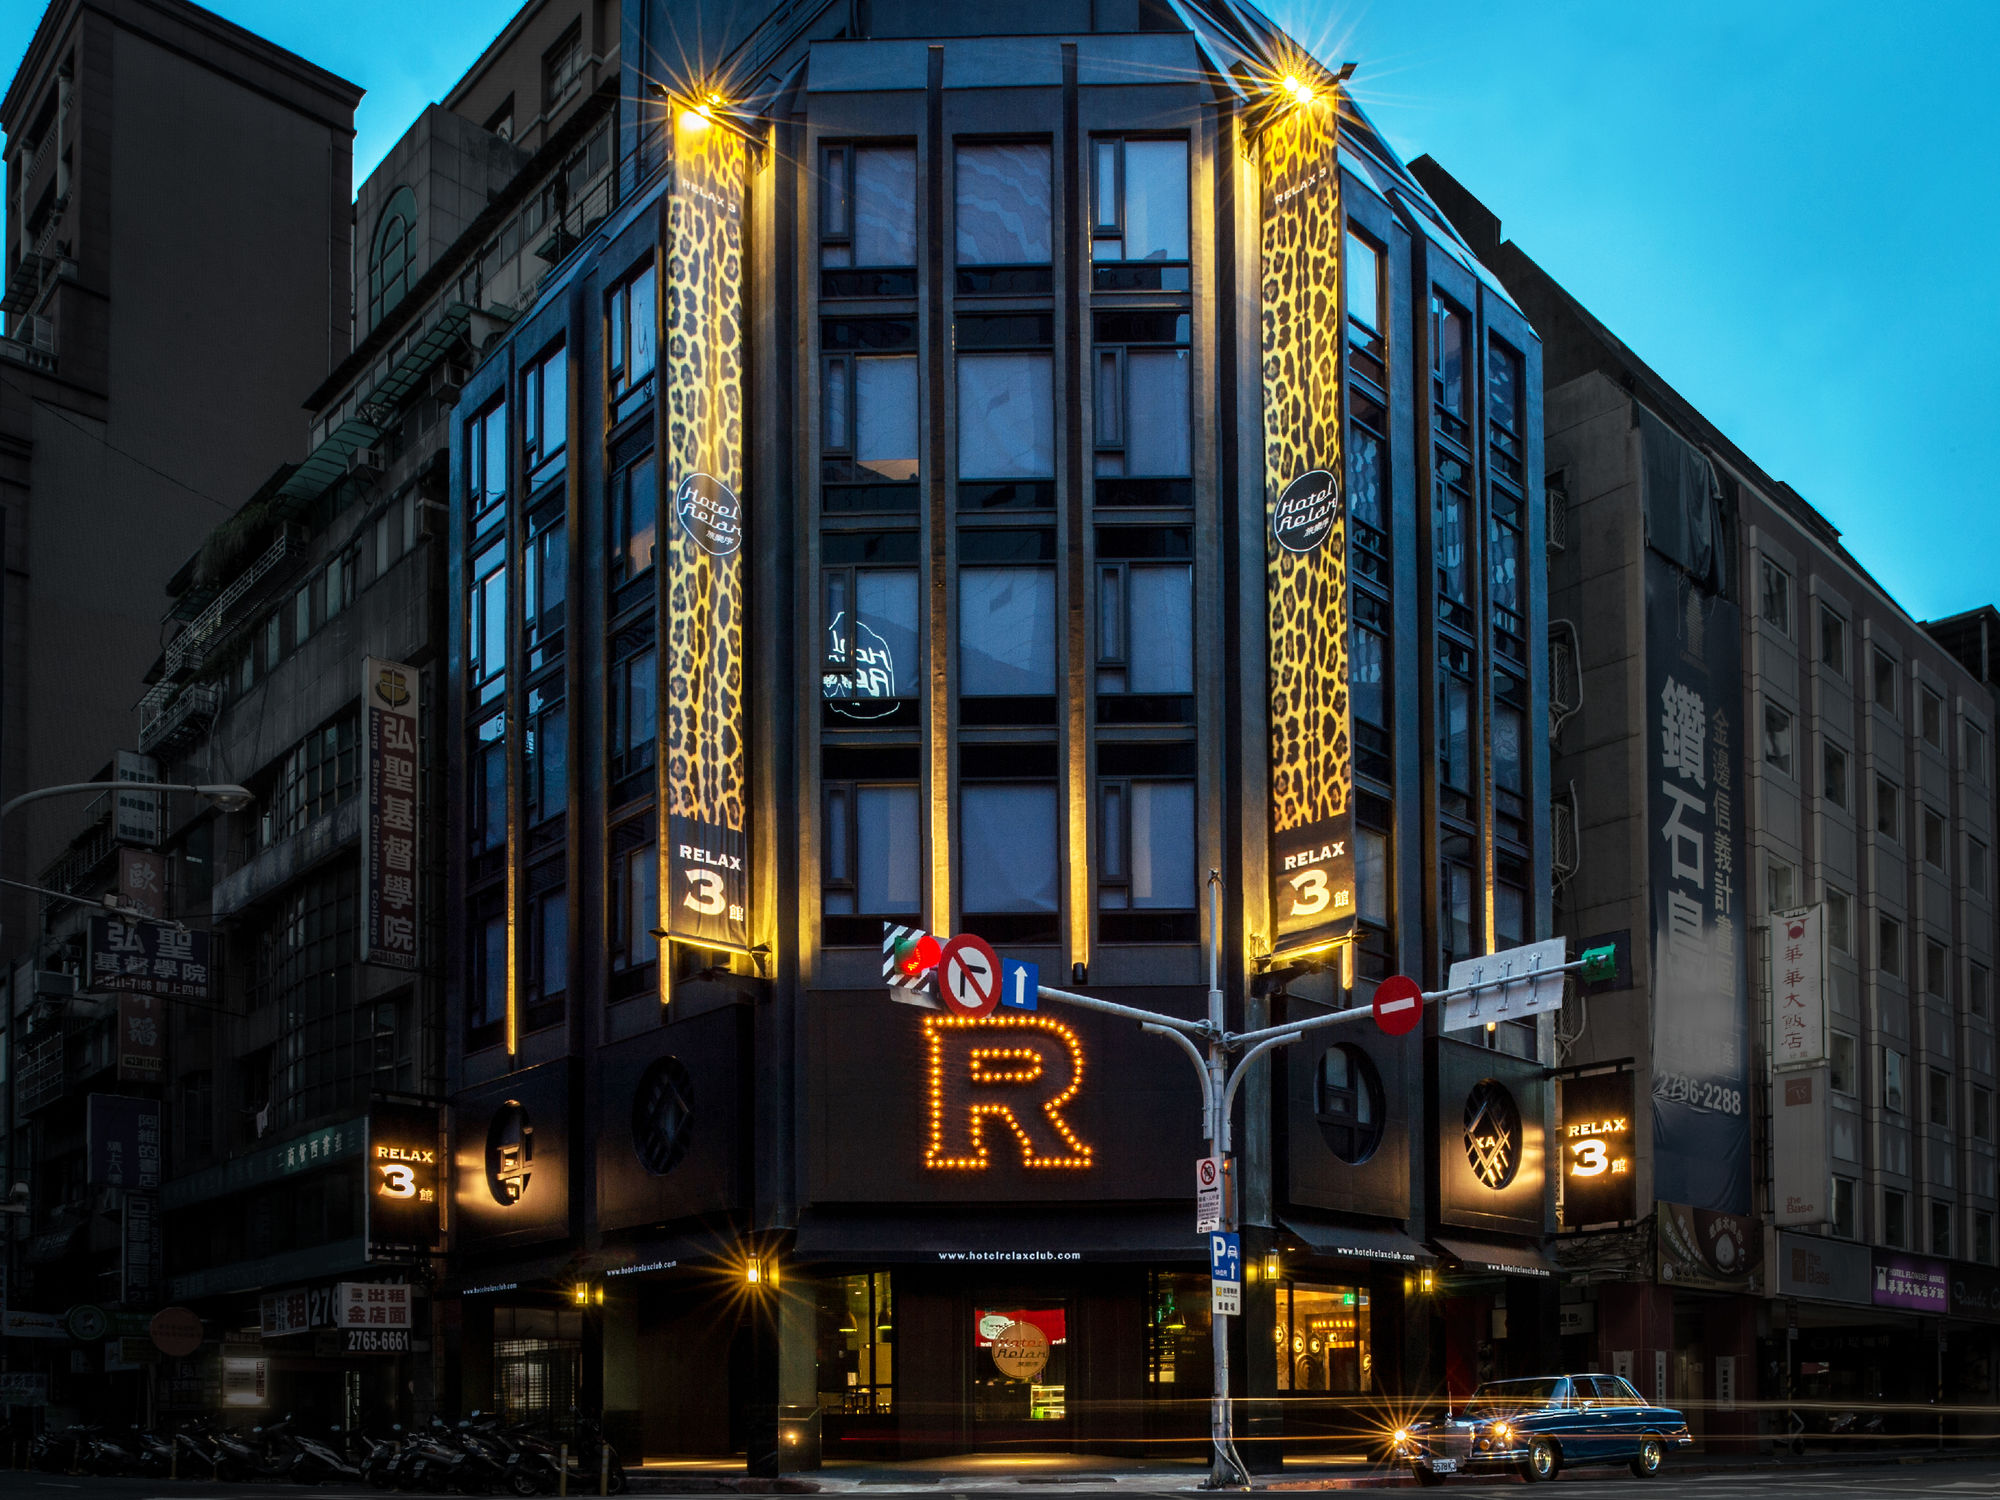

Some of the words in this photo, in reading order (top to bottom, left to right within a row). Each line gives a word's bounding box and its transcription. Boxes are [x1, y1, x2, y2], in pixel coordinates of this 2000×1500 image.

[682, 179, 724, 208] RELAX
[728, 202, 736, 213] 3
[1275, 173, 1316, 205] RELAX
[1319, 166, 1327, 178] 3
[680, 486, 738, 520] Hotel
[1277, 480, 1332, 518] Hotel
[371, 814, 380, 881] Christian
[383, 716, 414, 951] 弘聖基督學院
[680, 844, 742, 871] RELAX
[1284, 841, 1345, 870] RELAX
[107, 920, 195, 961] 弘聖
[95, 951, 208, 984] 基督學院
[922, 1015, 1093, 1168] R
[1659, 1070, 1742, 1115] 2796-2288
[1568, 1117, 1627, 1137] RELAX
[377, 1146, 434, 1163] RELAX
[1786, 1203, 1814, 1214] Base
[938, 1251, 1081, 1260] www.hotelrelaxclub.com
[1212, 1235, 1226, 1267] P
[1337, 1247, 1416, 1261] www.hotelrelaxclub.com
[368, 1288, 406, 1303] 出租
[348, 1305, 407, 1324] 金店面
